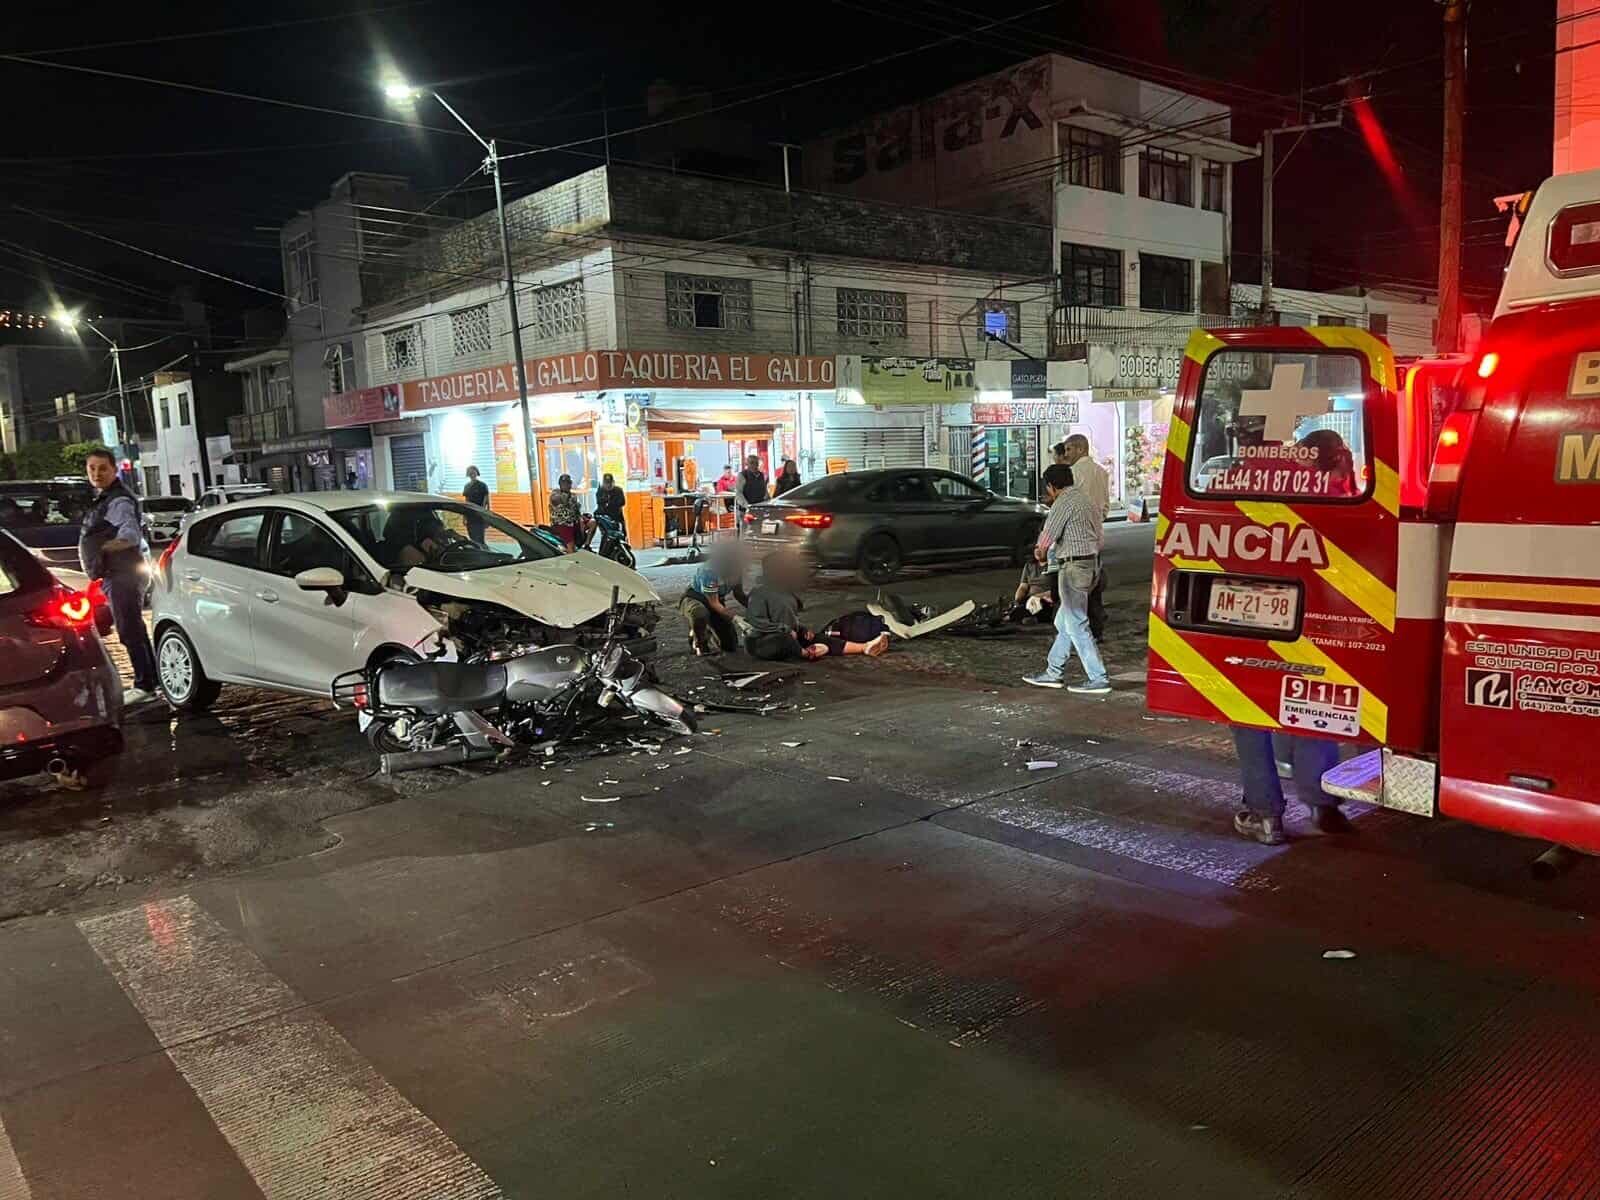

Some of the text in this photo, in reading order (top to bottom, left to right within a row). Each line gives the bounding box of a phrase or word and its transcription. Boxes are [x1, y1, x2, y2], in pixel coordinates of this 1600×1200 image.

[601, 352, 833, 383] TAQUERIA EL GALLO
[1119, 355, 1164, 378] BODEGA
[418, 354, 598, 403] TAQUERIA EL GALLO
[1237, 446, 1319, 460] BOMBEROS
[1254, 469, 1269, 491] 31
[1272, 470, 1291, 492] 87
[1293, 470, 1310, 493] 02
[1313, 470, 1330, 494] 31
[1154, 522, 1324, 565] ANCIA
[1216, 591, 1289, 616] AM-21-98
[1304, 612, 1348, 622] AMBULANCIA
[1348, 641, 1386, 651] 107-2023
[1465, 641, 1600, 662] ESTA UNIDAD FU
[1475, 656, 1557, 673] EQUIPADA
[1285, 705, 1356, 722] EMERGENCIAS
